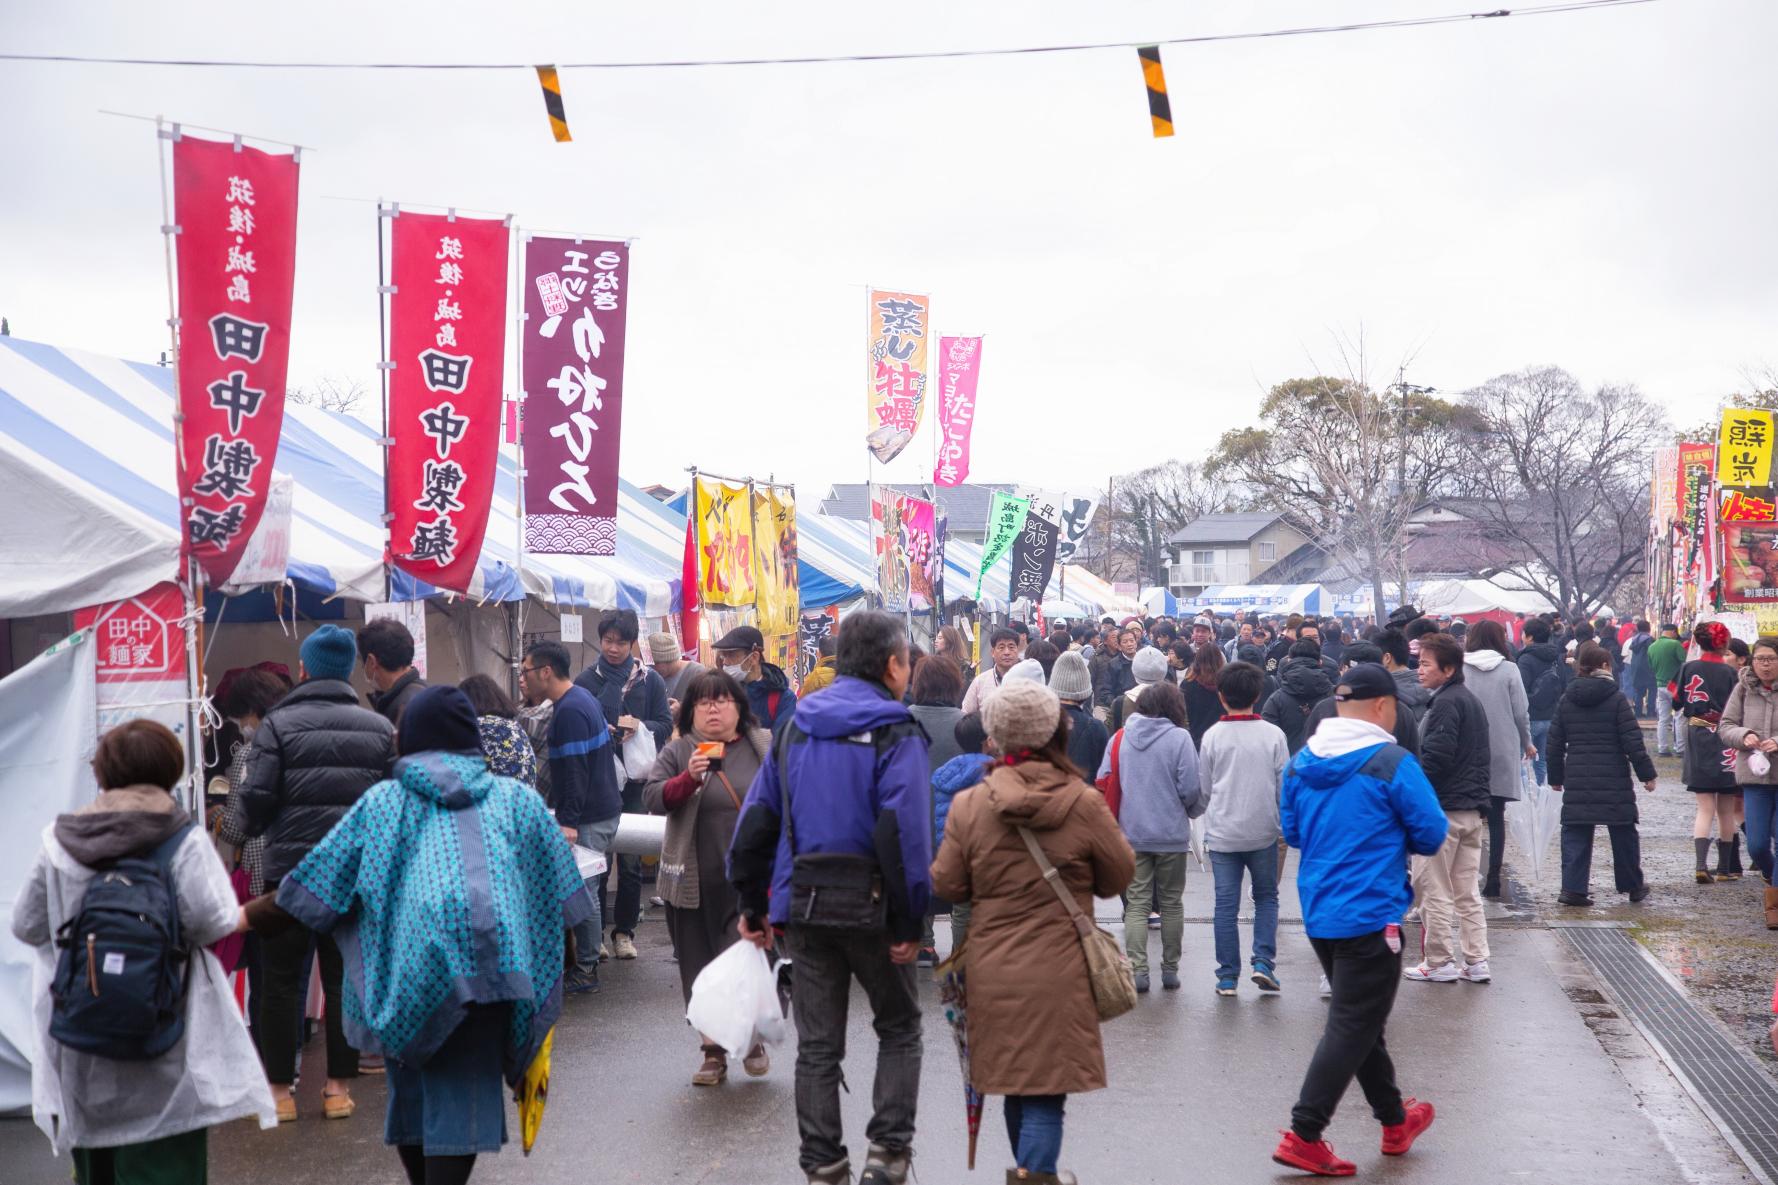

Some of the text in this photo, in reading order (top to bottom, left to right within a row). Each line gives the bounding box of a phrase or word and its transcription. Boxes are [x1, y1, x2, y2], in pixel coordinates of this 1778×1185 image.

[109, 616, 151, 639] 田中
[127, 636, 137, 645] の
[109, 643, 154, 665] 麺家
